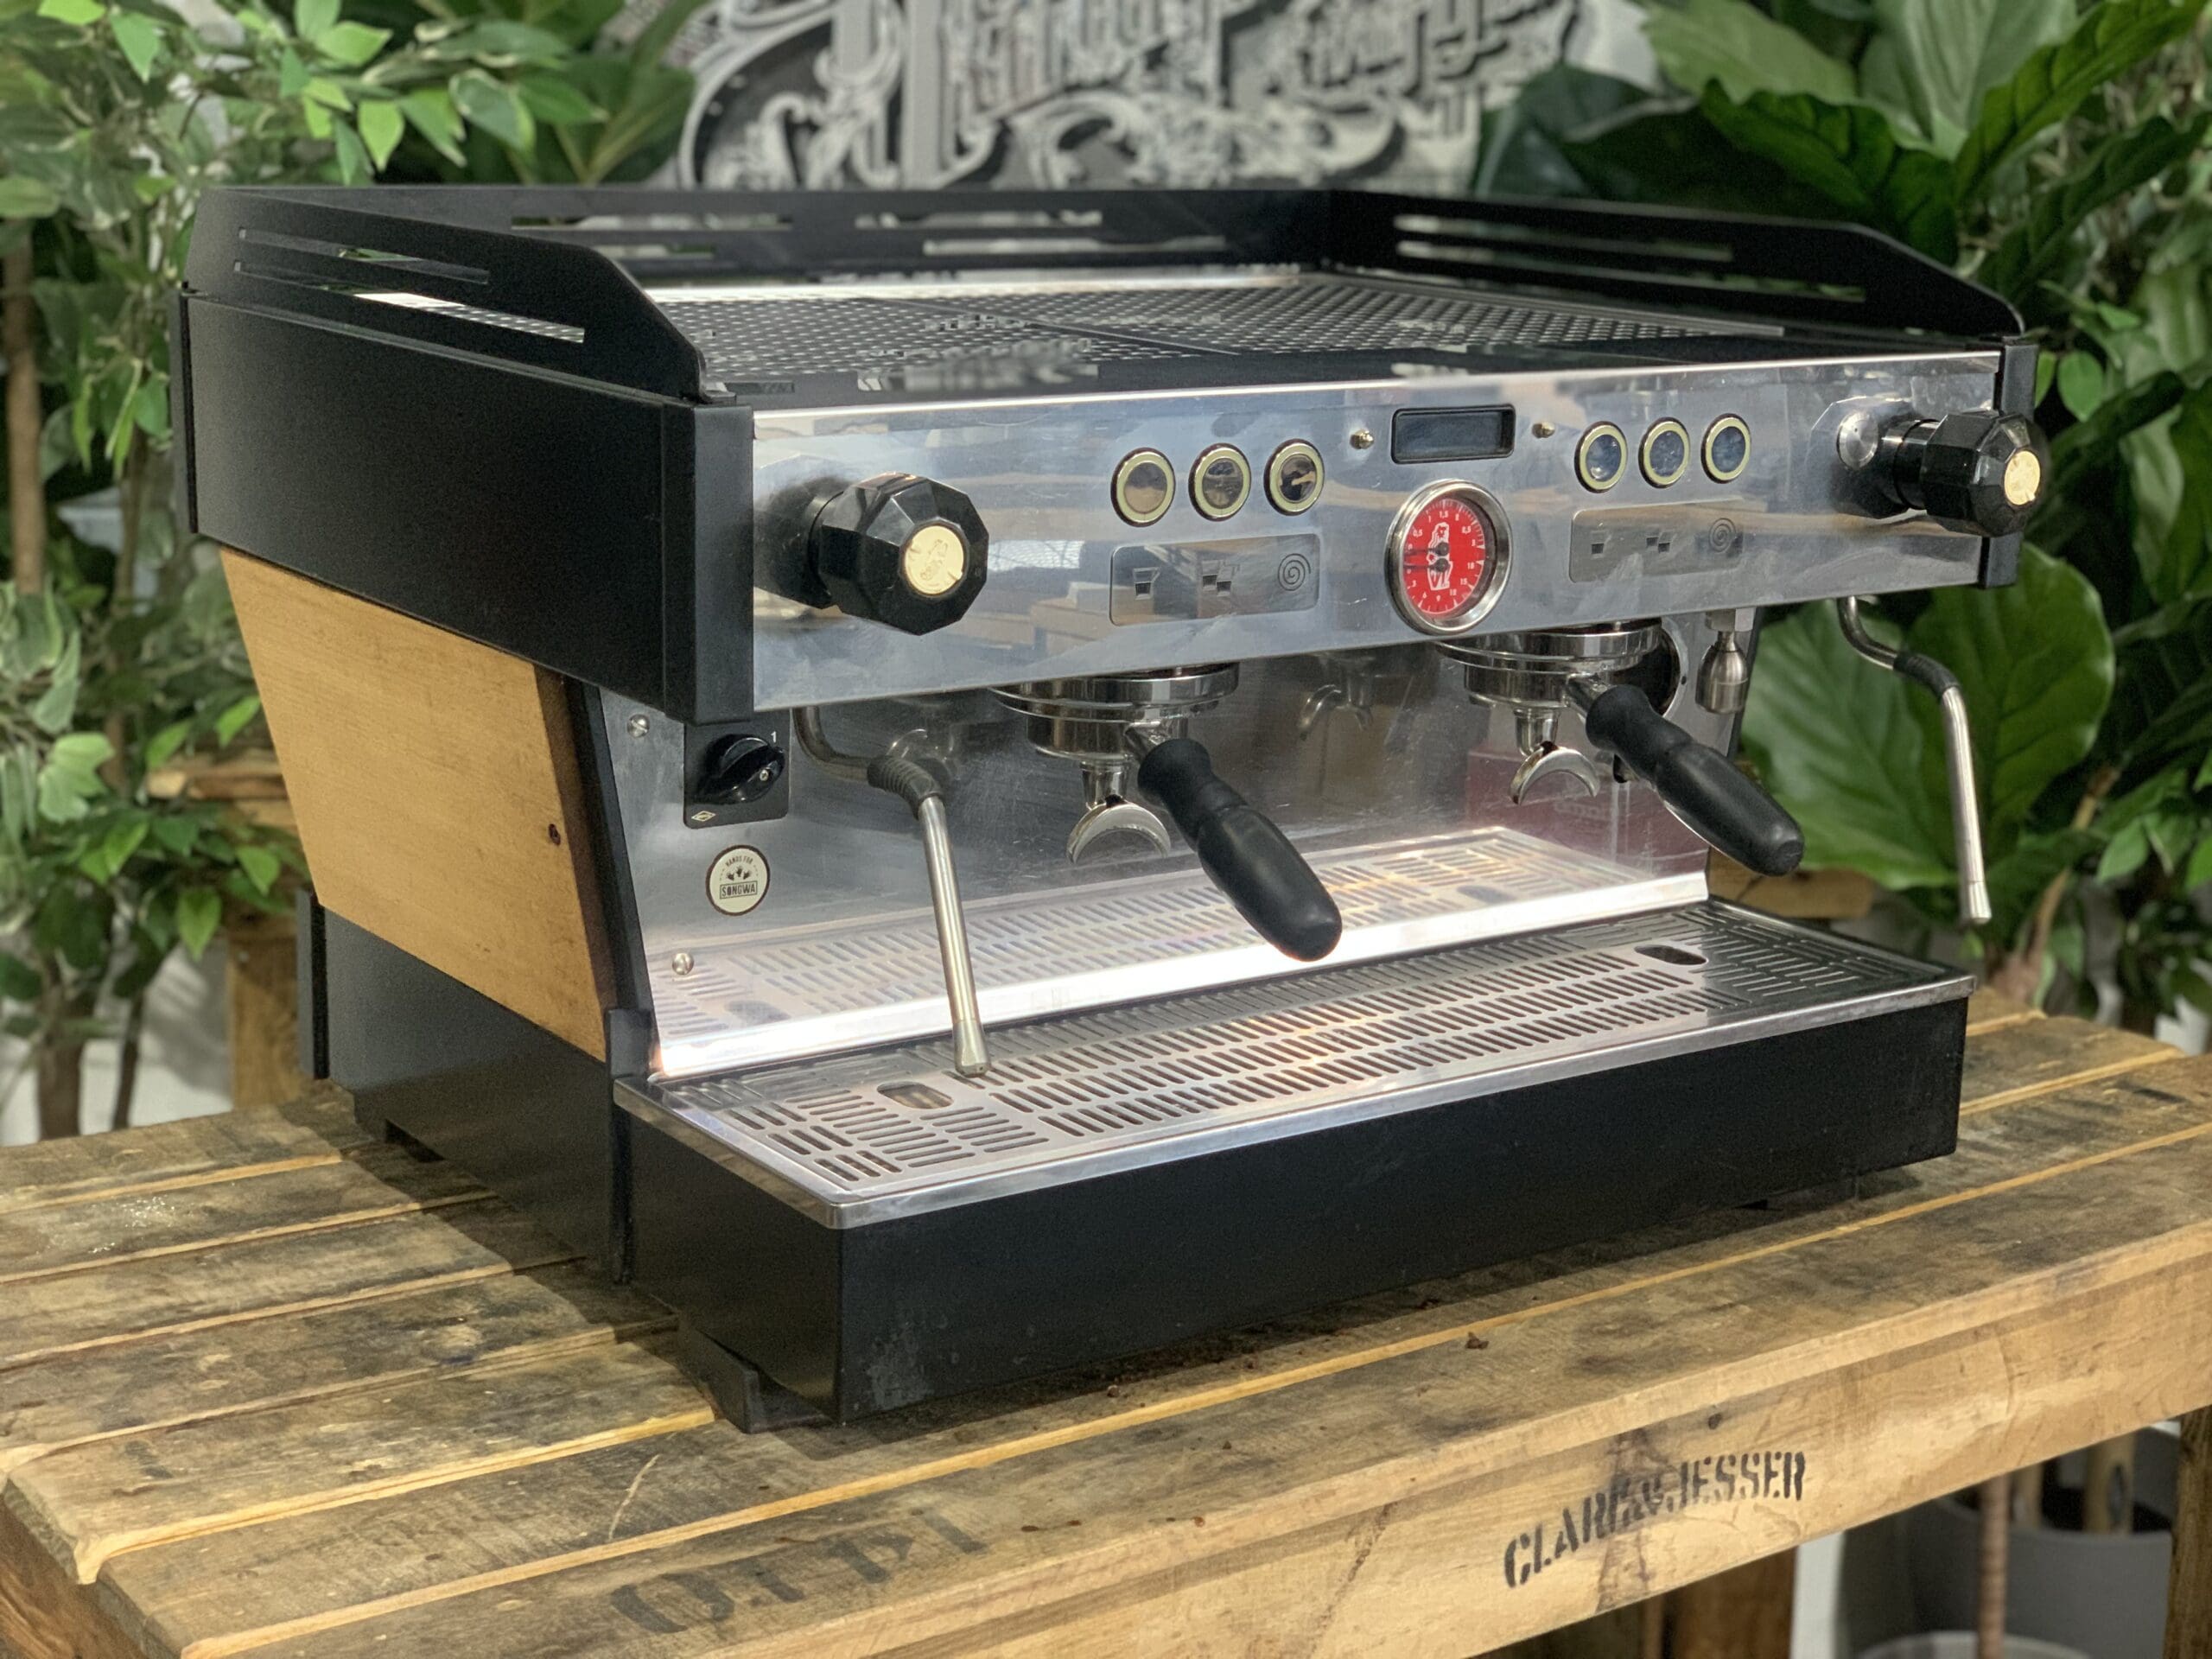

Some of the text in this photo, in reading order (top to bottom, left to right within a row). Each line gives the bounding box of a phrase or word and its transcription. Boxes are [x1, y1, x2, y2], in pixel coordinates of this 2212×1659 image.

[771, 731, 777, 743] 1
[725, 855, 753, 868] HANDS FOR
[721, 883, 756, 897] SONGWA
